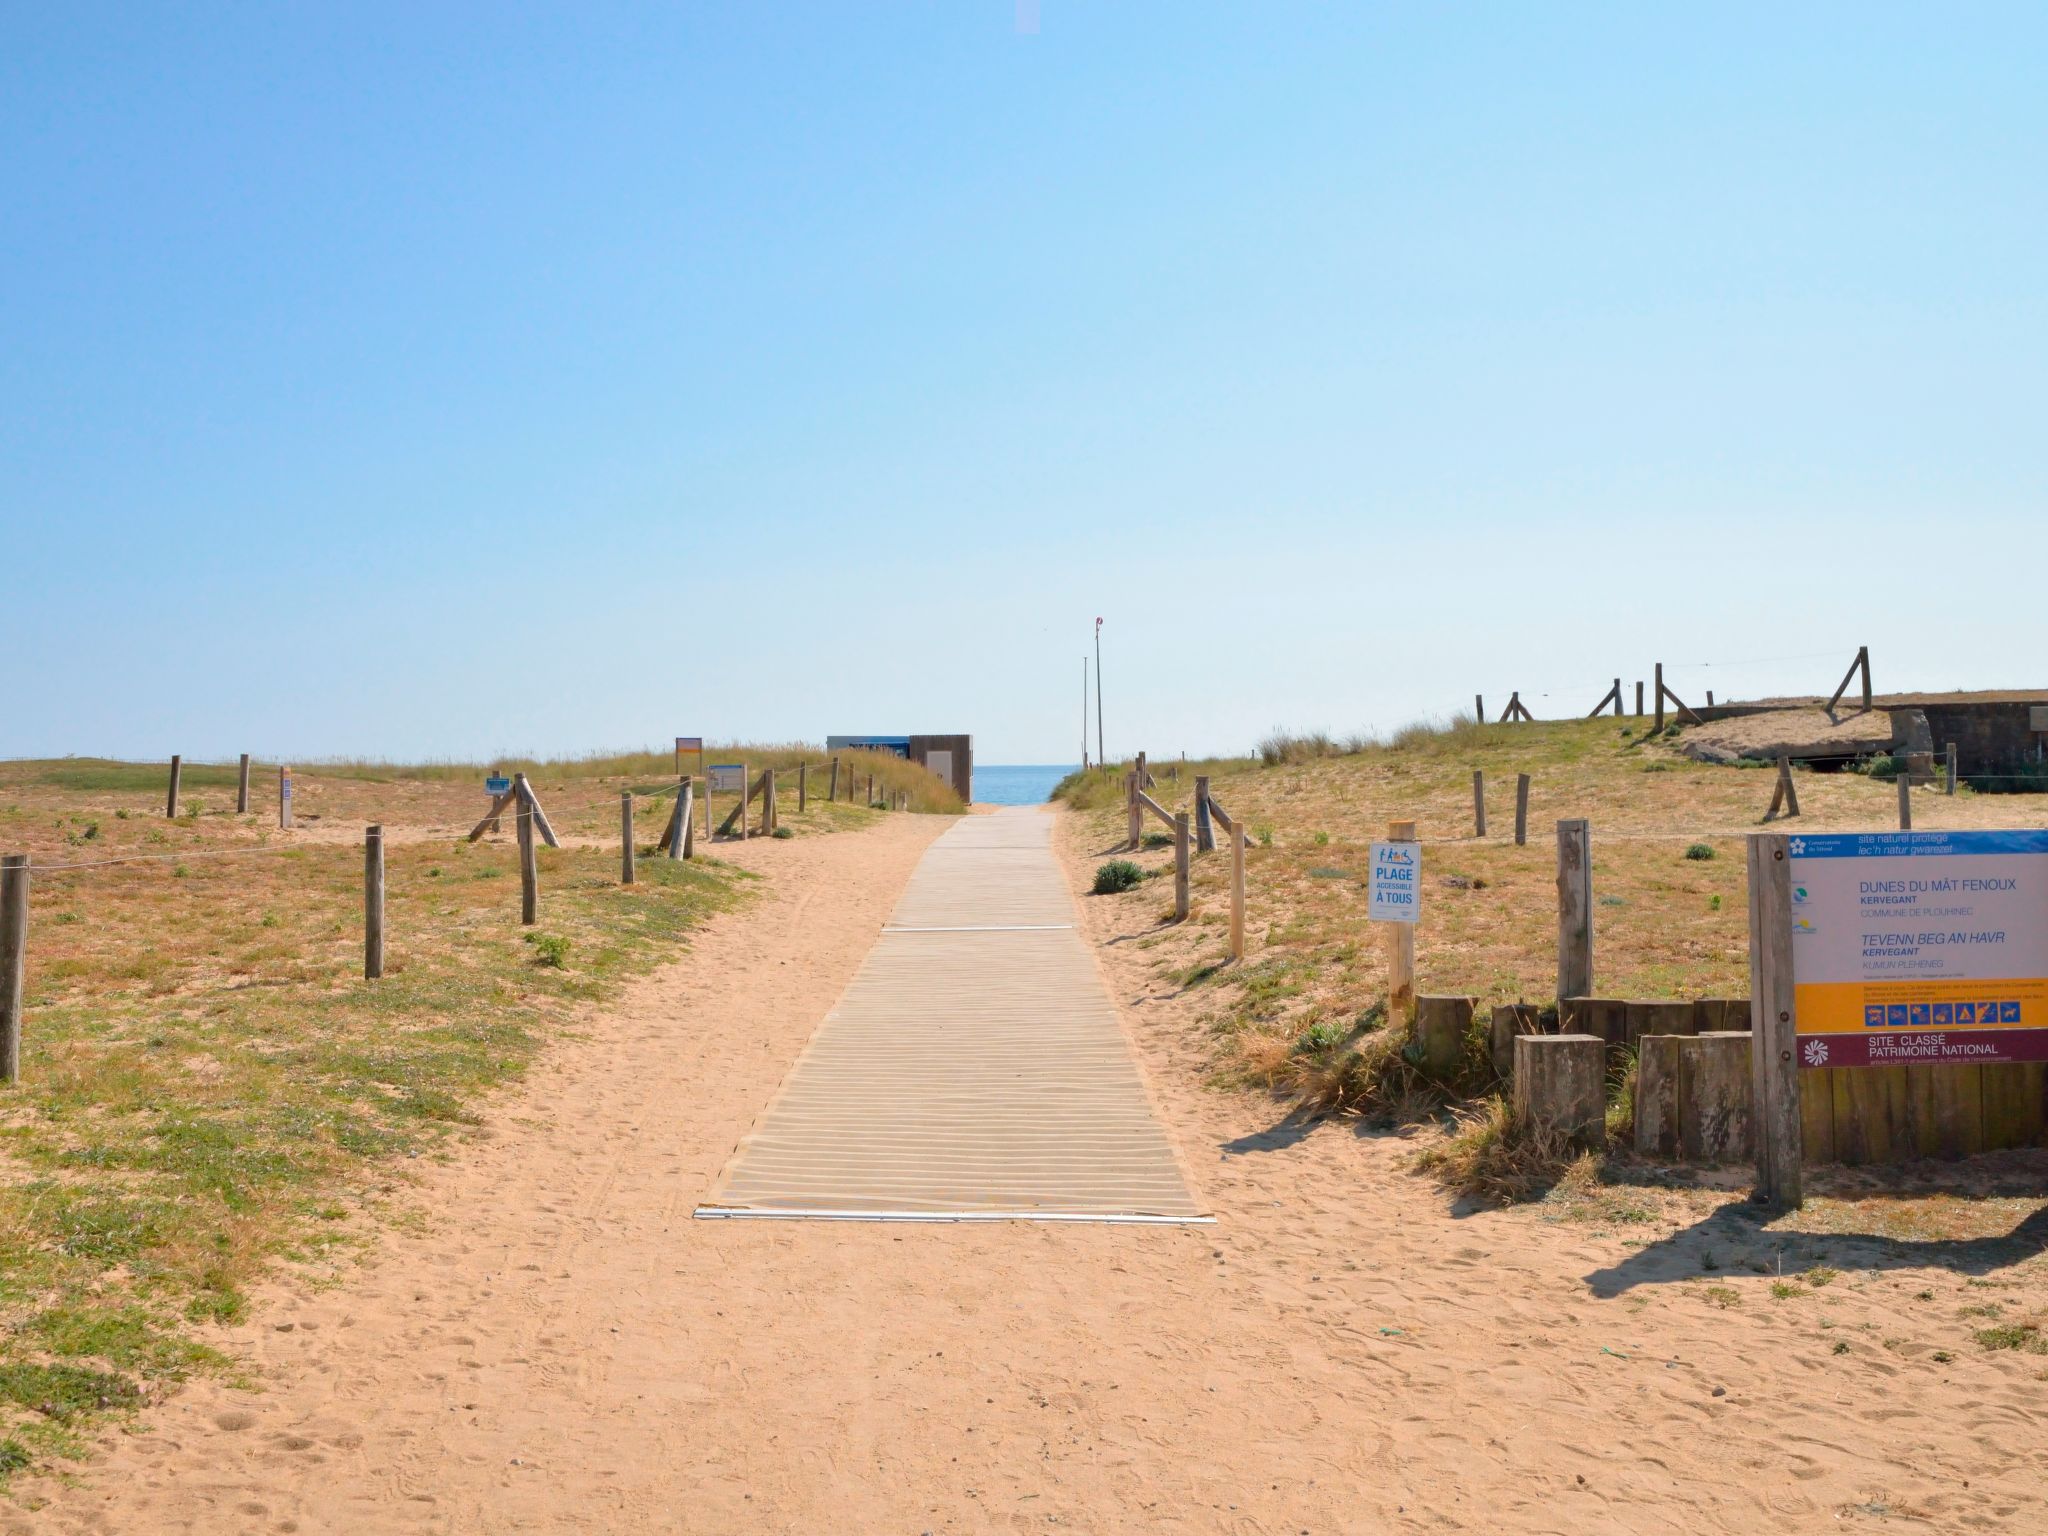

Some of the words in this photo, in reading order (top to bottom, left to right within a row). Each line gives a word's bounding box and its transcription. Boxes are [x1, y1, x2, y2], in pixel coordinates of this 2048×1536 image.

[1858, 834, 1875, 844] site
[1877, 834, 1909, 844] naturel
[1883, 845, 1907, 855] natur
[1376, 867, 1413, 880] PLAGE
[1376, 882, 1413, 890] ACCESSIBLE
[1860, 881, 1906, 893] DUNES
[1909, 880, 1928, 892] DU
[1962, 879, 2016, 891] FENOUX
[1376, 889, 1384, 903] À
[1386, 892, 1412, 904] TOUS
[1860, 896, 1918, 905] KERVEGANT
[1860, 909, 1907, 918] COMMUNE
[1909, 908, 1921, 917] DE
[1923, 907, 1974, 917] PLOUHINEC
[1862, 934, 1915, 946] TEVENN
[1917, 933, 1945, 945] BEG
[1948, 932, 1966, 944] AN
[1969, 931, 2006, 944] HAVR
[1862, 948, 1920, 957] KERVEGANT
[1862, 961, 1899, 969] KUMUN
[1900, 960, 1944, 968] PLEHENEG
[1868, 1036, 1894, 1047] SITE
[1900, 1033, 1946, 1046] CLASSÉ
[1869, 1046, 1939, 1057] PATRIMOINE
[1942, 1044, 1999, 1055] NATIONAL
